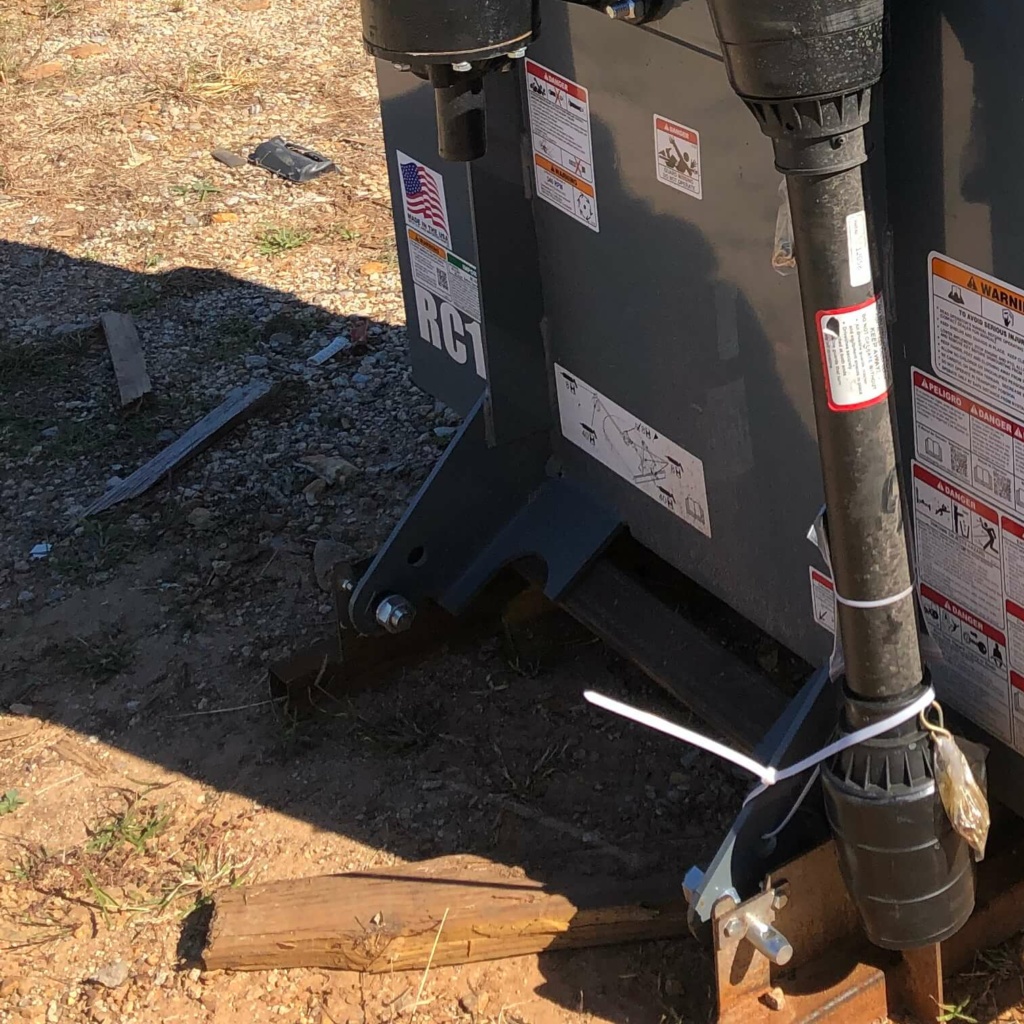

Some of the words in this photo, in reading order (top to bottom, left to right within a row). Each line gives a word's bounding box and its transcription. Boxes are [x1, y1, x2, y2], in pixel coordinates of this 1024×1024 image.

[547, 74, 568, 92] DANGER
[407, 213, 420, 225] MADE
[427, 224, 437, 234] THE
[958, 309, 965, 318] TO
[966, 313, 983, 326] AVOID
[983, 320, 1006, 337] SERIOUS
[869, 326, 877, 348] KEEP
[928, 382, 962, 407] PELIGRO
[978, 407, 1011, 434] DANGER
[945, 485, 975, 510] DANGER
[952, 606, 983, 631] DANGER
